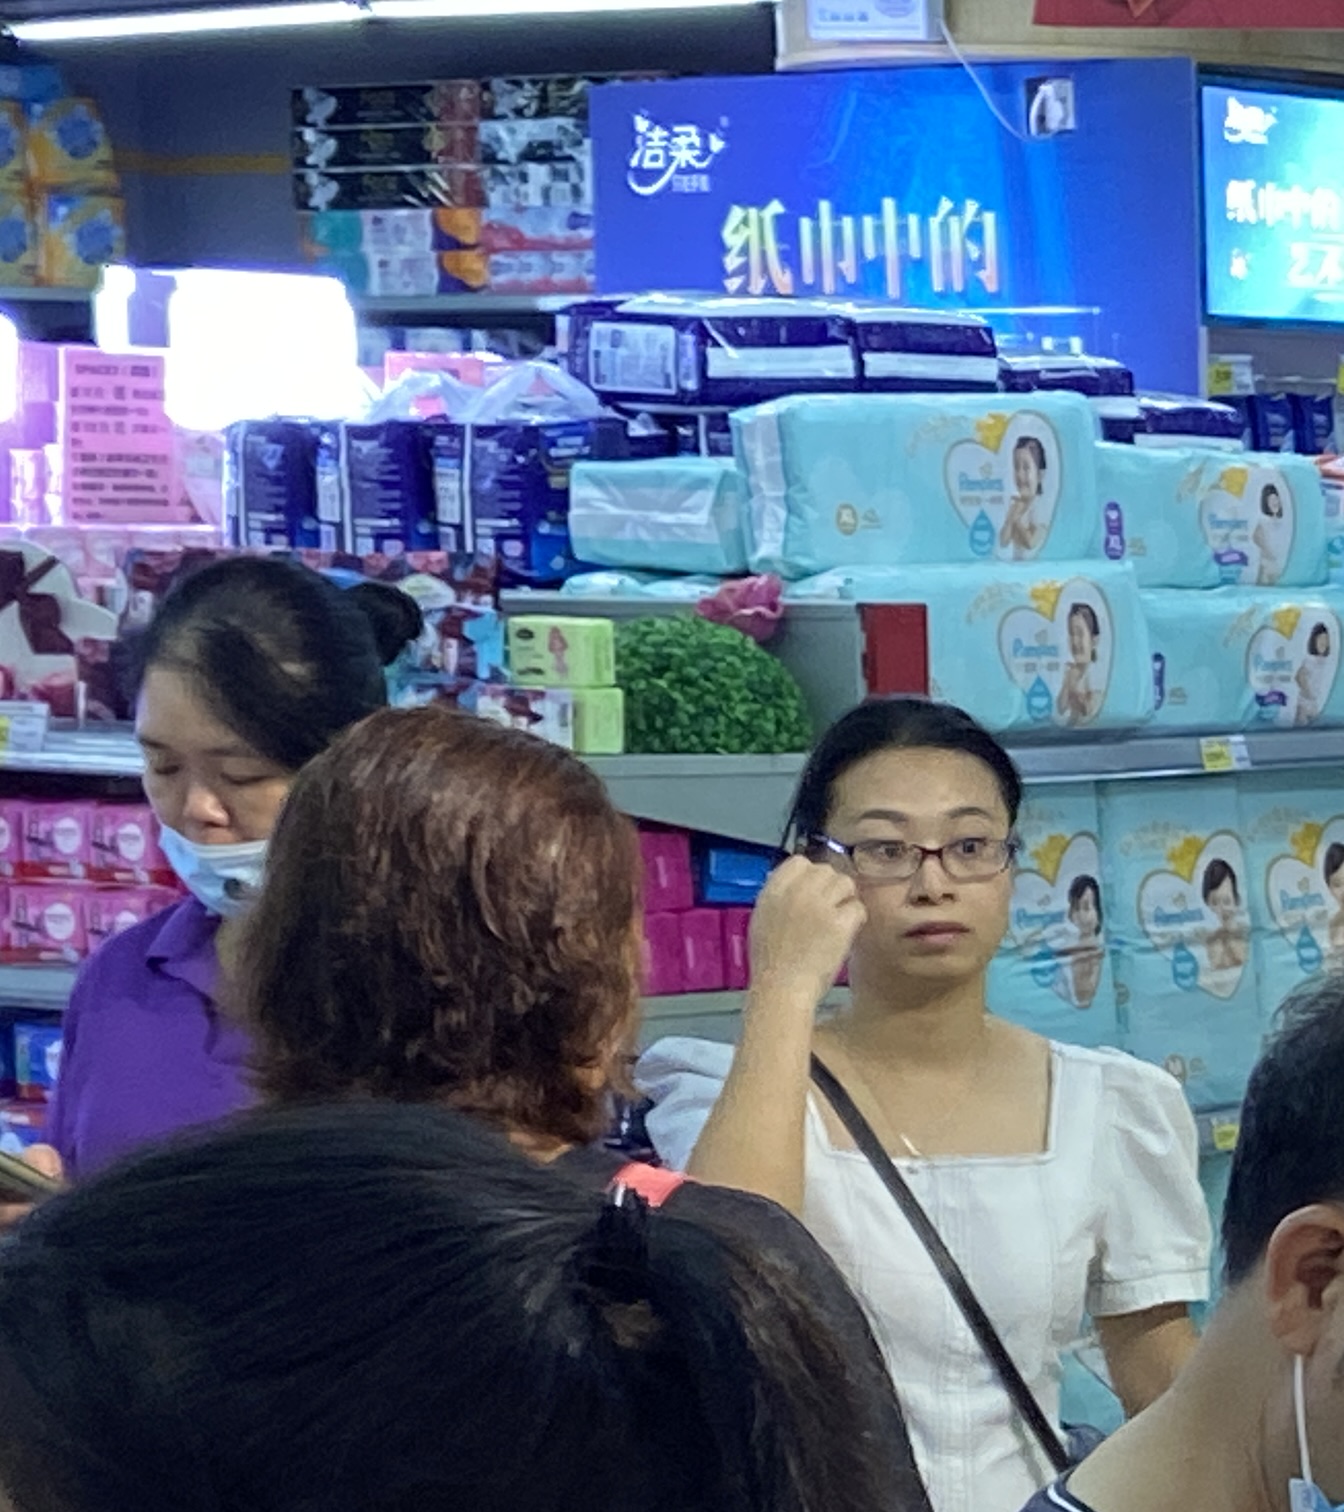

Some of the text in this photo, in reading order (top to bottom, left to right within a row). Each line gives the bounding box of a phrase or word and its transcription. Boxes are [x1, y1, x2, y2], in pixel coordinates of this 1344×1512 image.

[628, 118, 713, 193] 洁柔
[721, 196, 1000, 299] 纸巾中的
